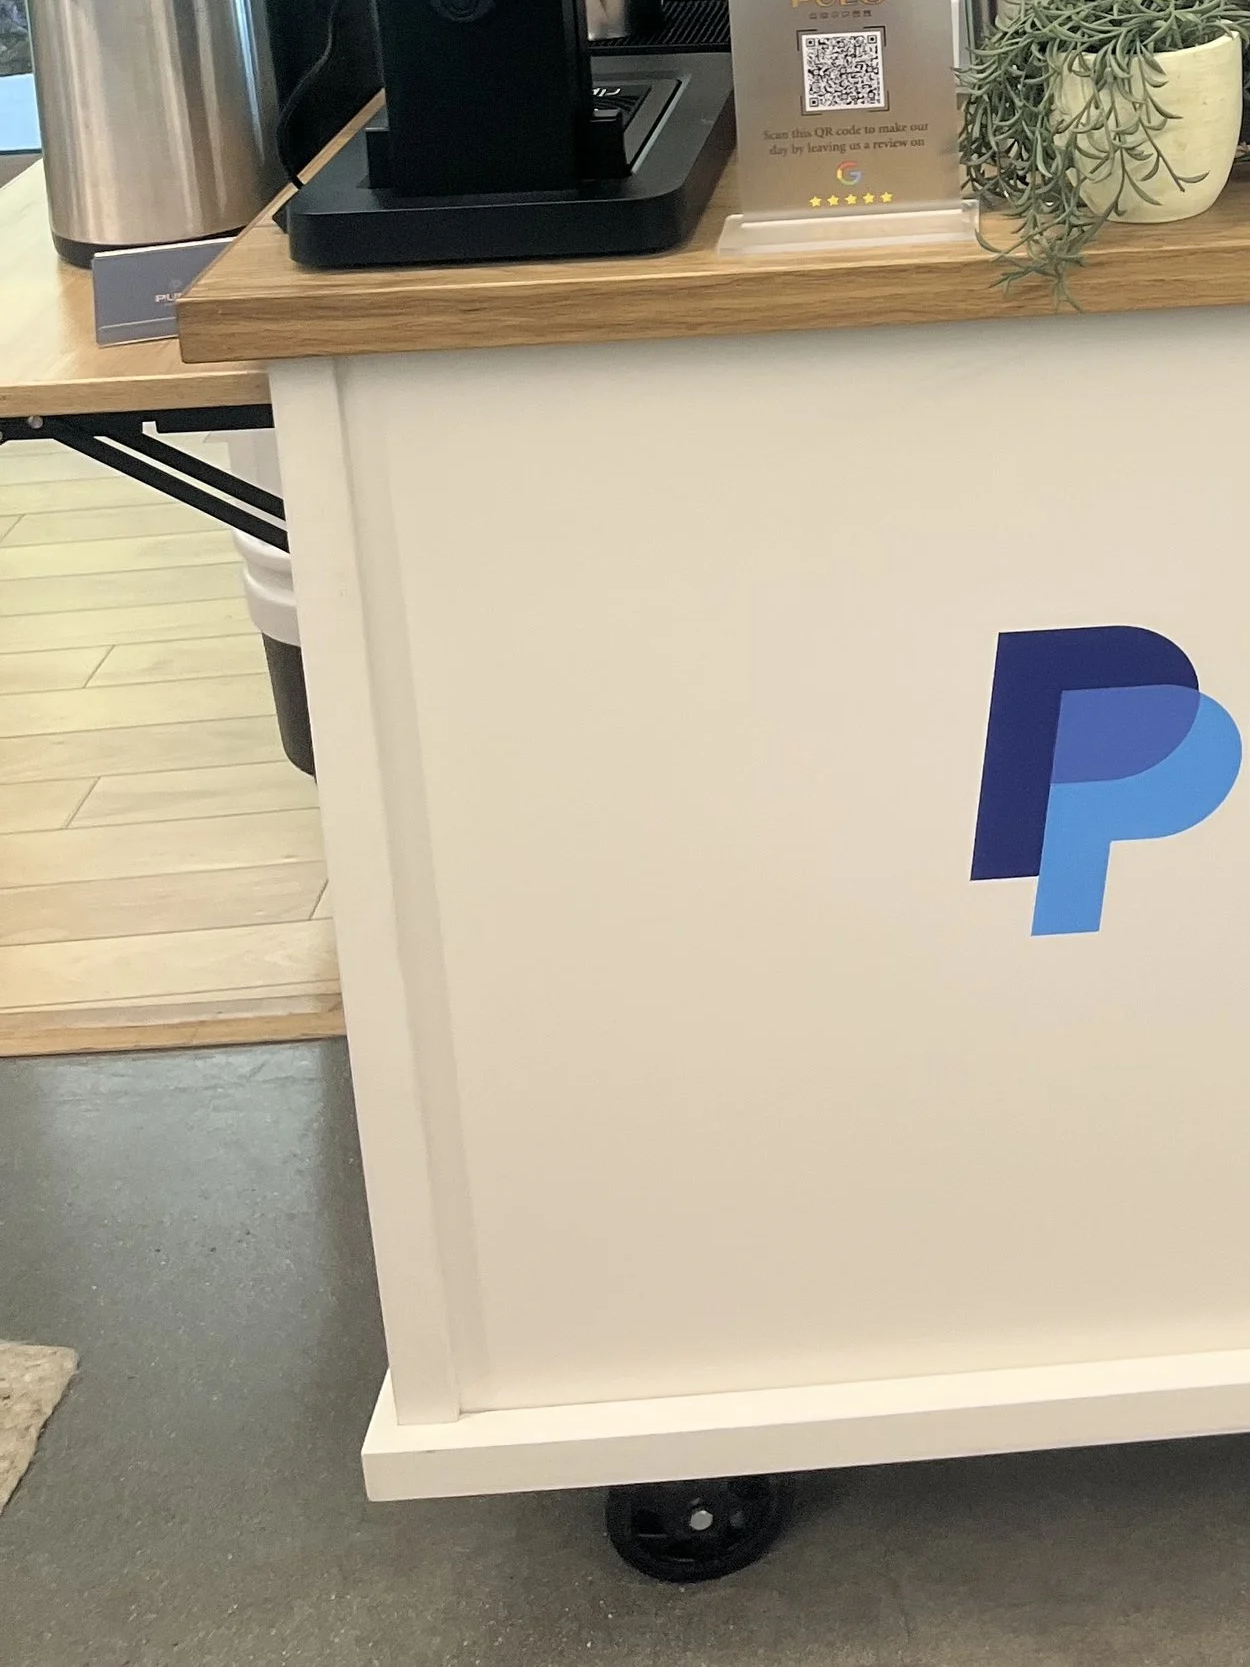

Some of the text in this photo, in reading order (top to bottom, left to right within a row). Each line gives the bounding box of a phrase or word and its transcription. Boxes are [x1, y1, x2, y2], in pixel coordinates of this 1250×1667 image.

[763, 122, 928, 140] Scan this QR code to make our
[769, 138, 925, 157] day by leaving us a review on
